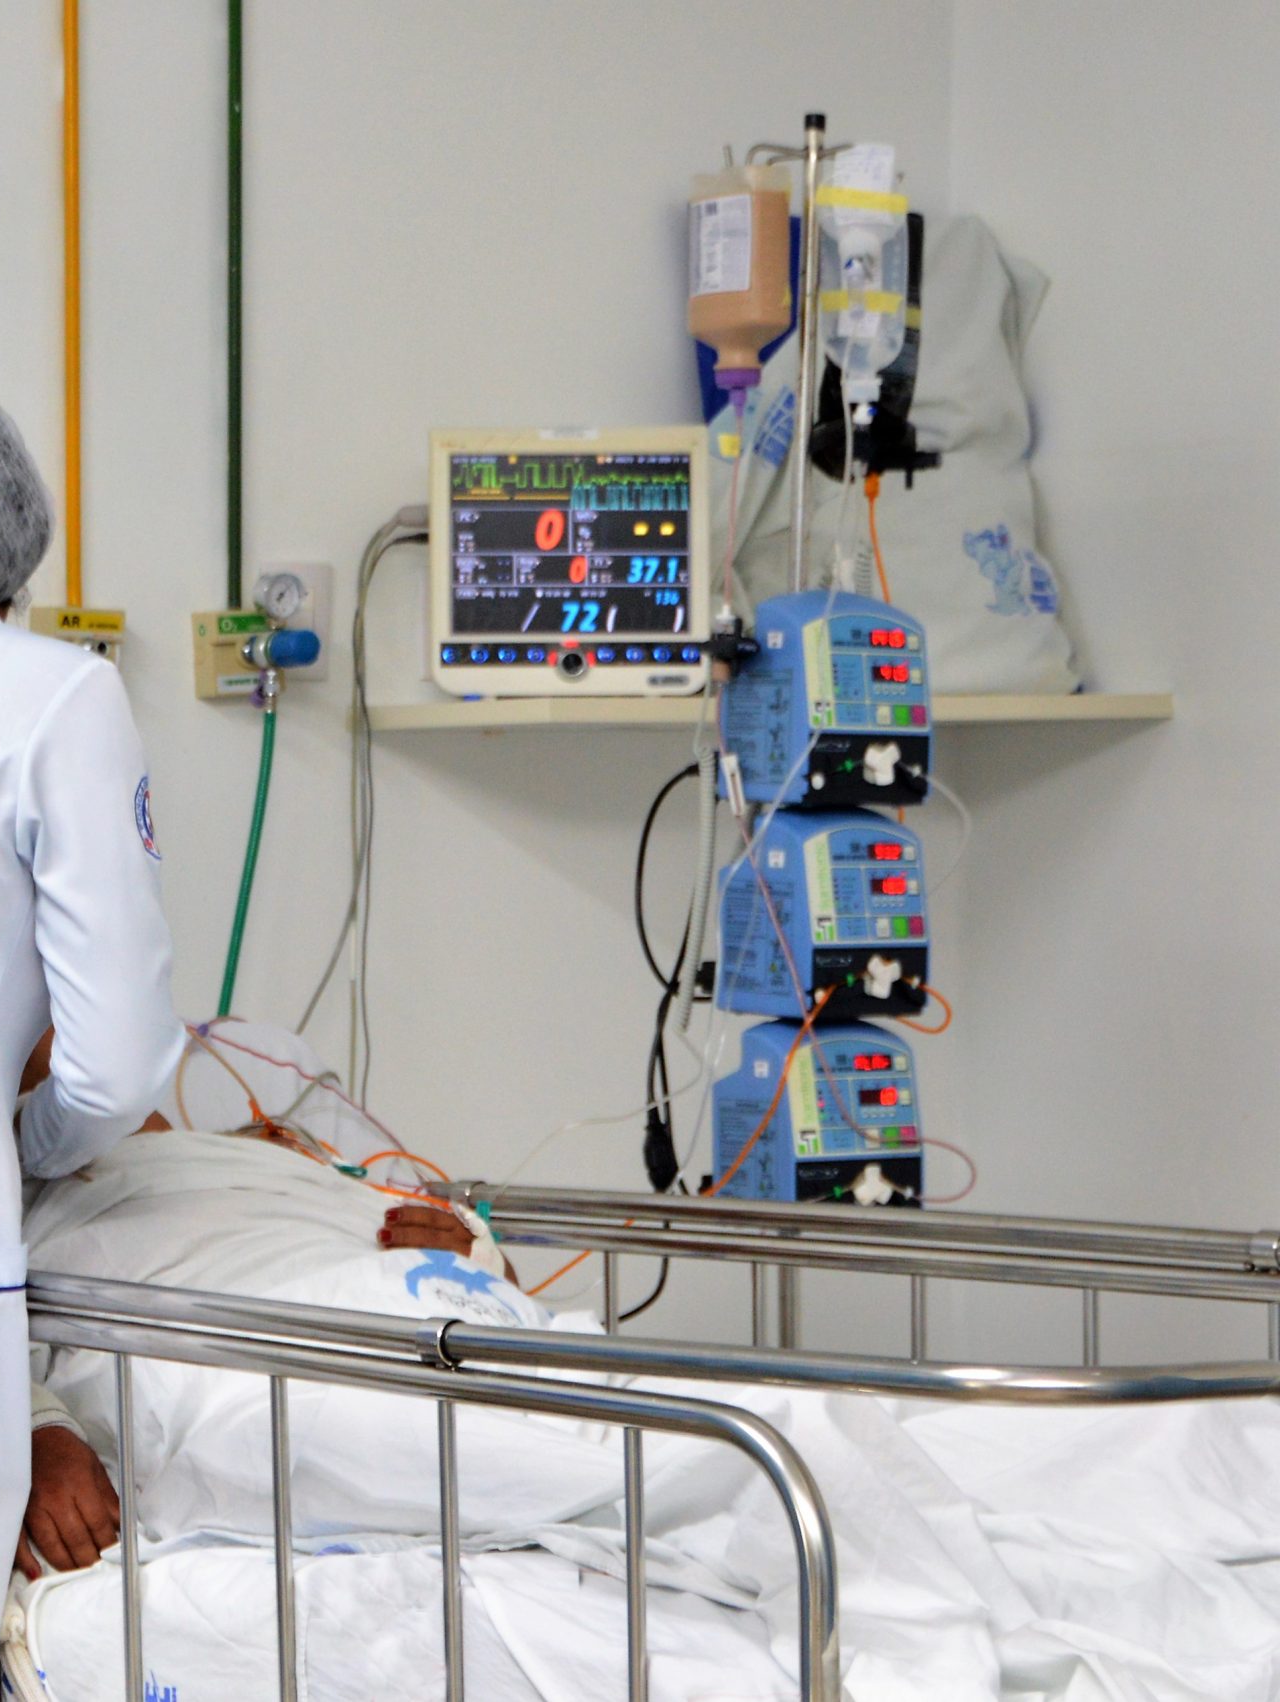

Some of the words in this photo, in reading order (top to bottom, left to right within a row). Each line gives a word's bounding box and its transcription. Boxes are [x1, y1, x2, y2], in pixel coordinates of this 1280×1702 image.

[535, 508, 566, 551] 0
[627, 555, 679, 584] 37.1
[62, 616, 80, 628] AR
[561, 600, 600, 633] 72
